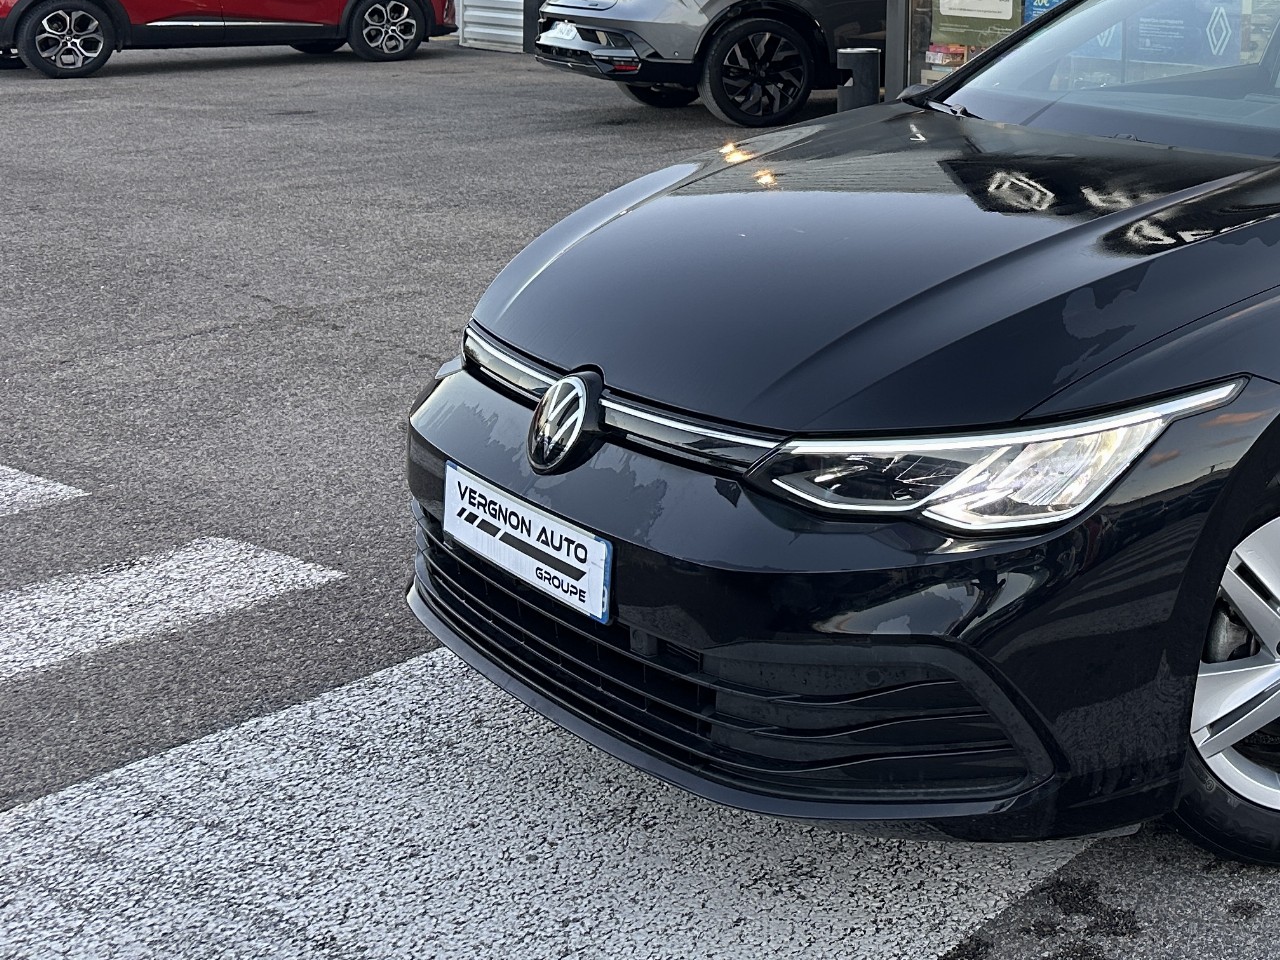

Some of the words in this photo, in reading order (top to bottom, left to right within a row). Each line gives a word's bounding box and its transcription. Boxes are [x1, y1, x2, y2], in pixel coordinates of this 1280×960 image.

[457, 481, 532, 538] VERGNON
[536, 526, 588, 564] AUTO
[535, 566, 587, 604] GROUPE
